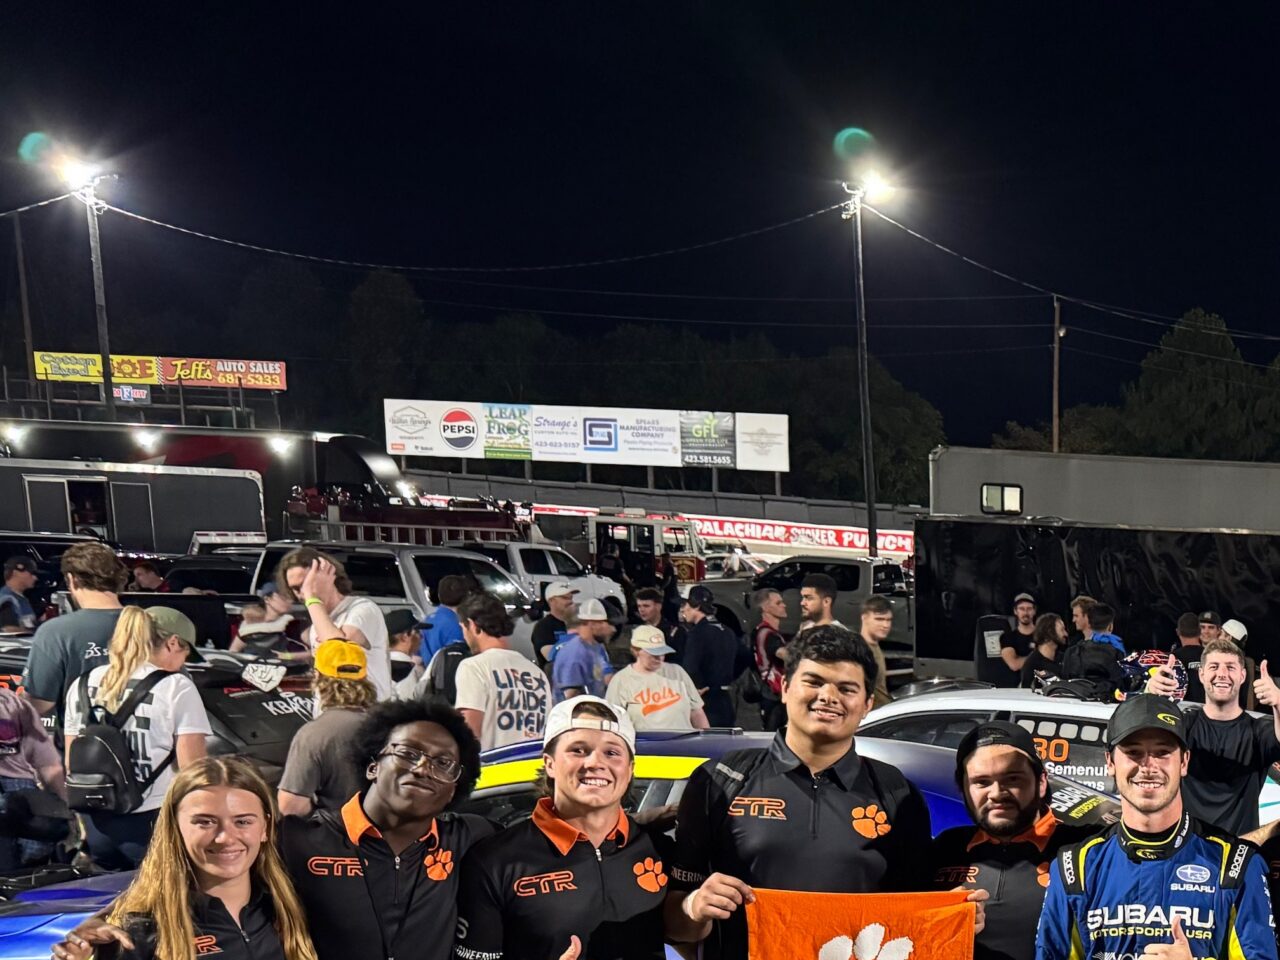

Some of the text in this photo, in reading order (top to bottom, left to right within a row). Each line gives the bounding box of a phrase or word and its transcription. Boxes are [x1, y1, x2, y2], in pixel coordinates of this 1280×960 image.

[167, 360, 212, 380] Jeff's
[216, 361, 281, 374] AUTO SALES
[486, 405, 527, 420] LEAP
[443, 425, 475, 434] PEPSI
[486, 421, 529, 436] FROG
[534, 416, 578, 430] Strange's
[620, 425, 677, 433] MANUFACTURING
[692, 424, 719, 438] GFL
[634, 687, 678, 705] Vols
[727, 796, 786, 819] CTR
[307, 856, 368, 877] CTR
[1228, 843, 1247, 879] sparco
[513, 870, 577, 897] CTR
[1170, 882, 1216, 894] SUBARU
[1087, 904, 1215, 930] SUBARU
[1186, 930, 1213, 940] USA
